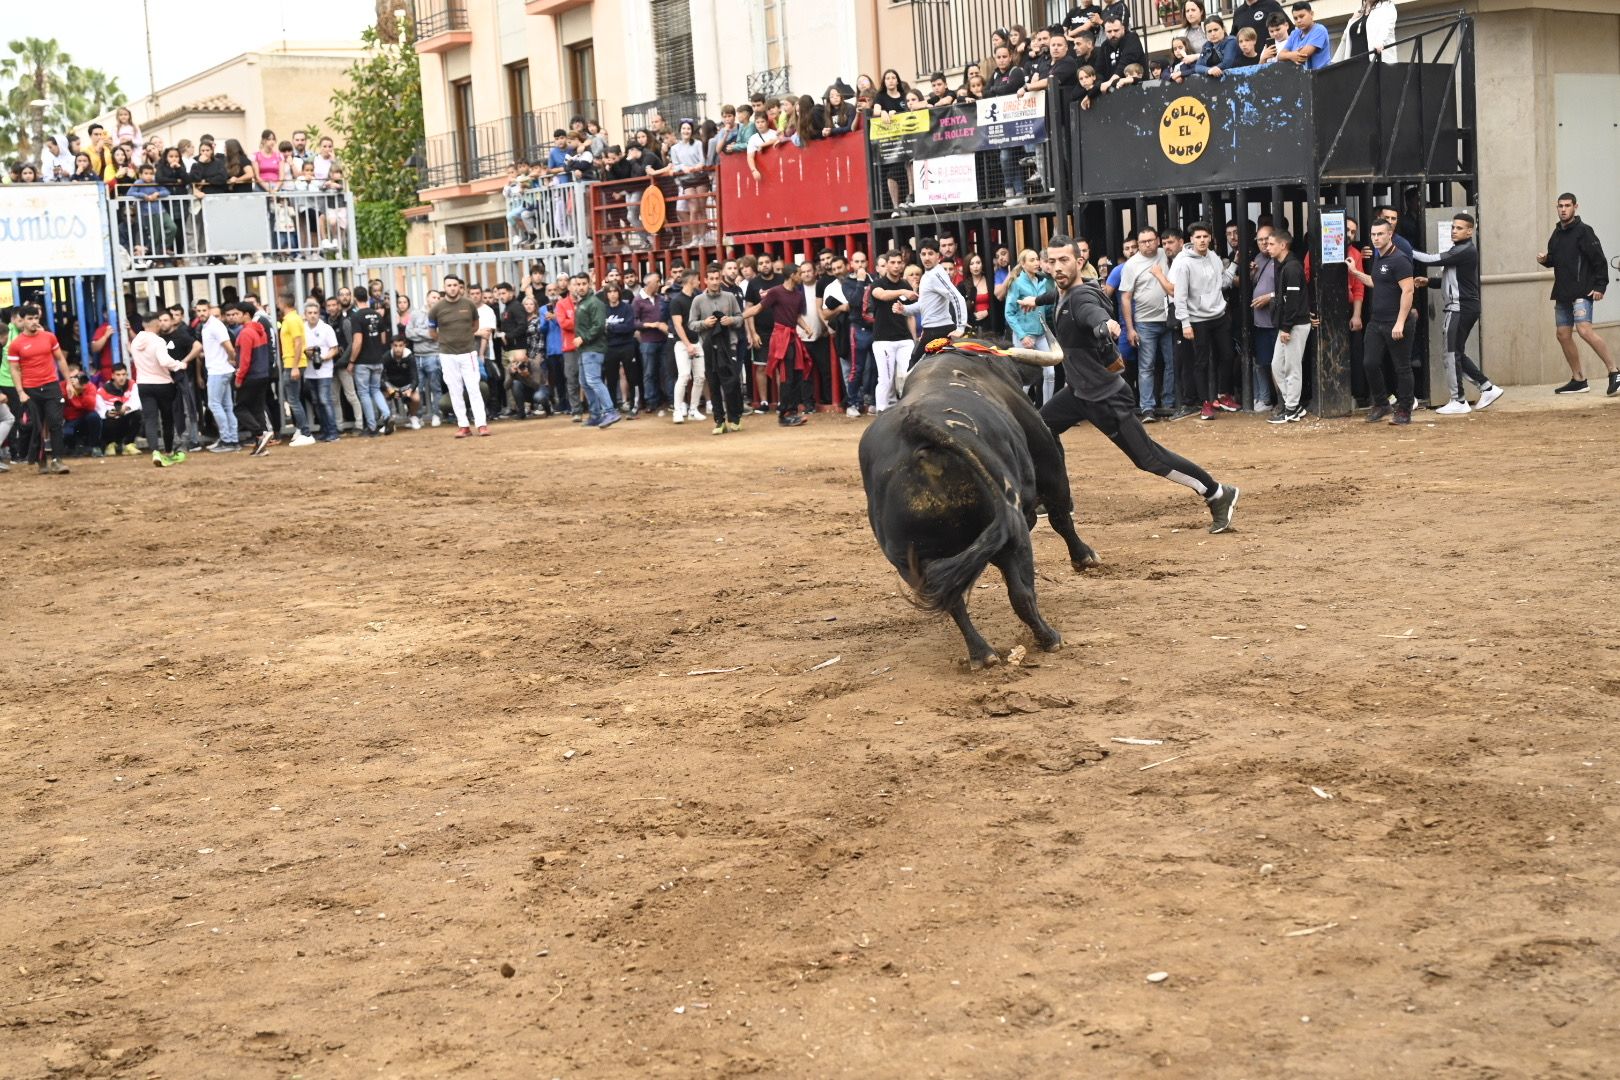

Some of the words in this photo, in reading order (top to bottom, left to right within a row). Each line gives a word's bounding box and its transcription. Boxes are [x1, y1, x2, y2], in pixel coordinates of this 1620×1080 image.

[939, 116, 968, 127] PENYA
[1163, 105, 1206, 127] COLLA
[944, 127, 975, 140] ROLLET
[1179, 125, 1191, 137] EL
[1168, 141, 1203, 156] DURO
